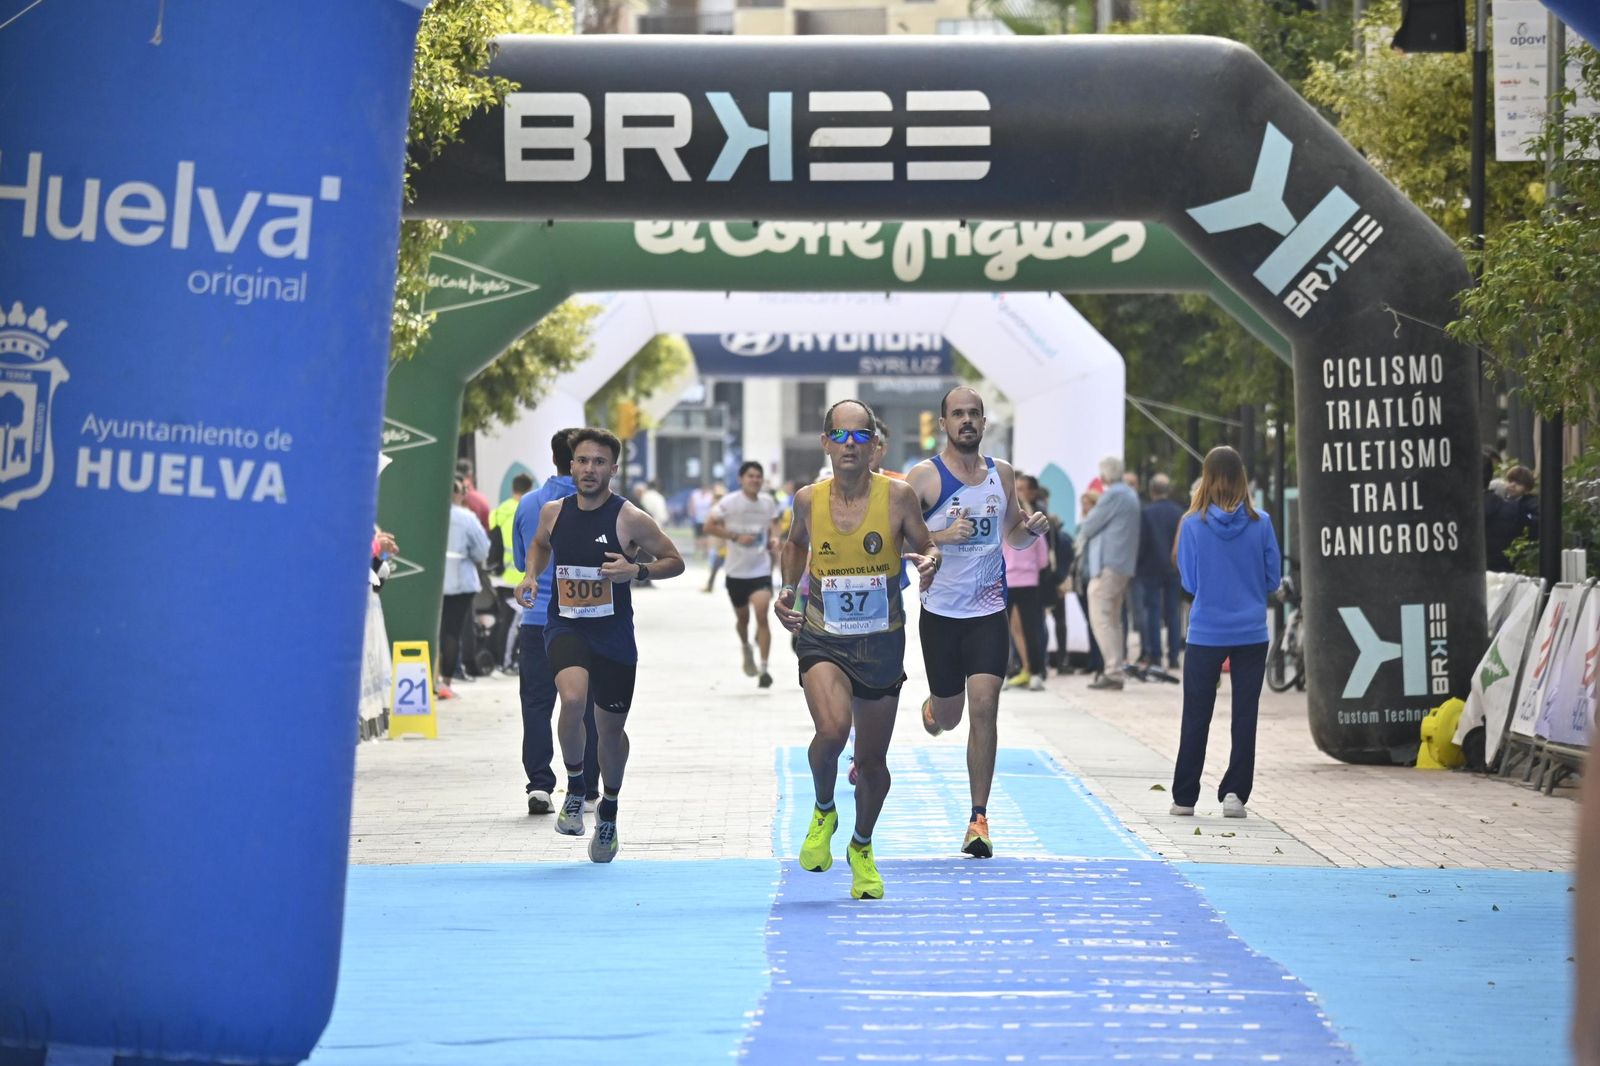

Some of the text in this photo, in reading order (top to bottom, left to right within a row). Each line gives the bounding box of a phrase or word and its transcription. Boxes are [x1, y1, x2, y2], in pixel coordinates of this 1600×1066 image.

[0, 151, 315, 261] Huelva
[188, 265, 307, 305] original
[1322, 353, 1443, 388] CICLISMO
[1325, 391, 1442, 430] TRIATLÓN
[81, 413, 259, 449] Ayuntamiento
[264, 427, 294, 452] de
[1321, 437, 1451, 473] ATLETISMO
[75, 447, 288, 505] HUELVA
[1349, 481, 1423, 513] TRAIL
[1320, 521, 1459, 557] CANICROSS
[825, 577, 882, 588] 2K 2K
[827, 567, 855, 576] ARROYO
[866, 564, 875, 573] LA
[565, 580, 603, 599] 306
[840, 592, 869, 613] 37
[840, 622, 870, 630] Huelva
[398, 678, 427, 706] 21
[1338, 710, 1379, 725] Custom
